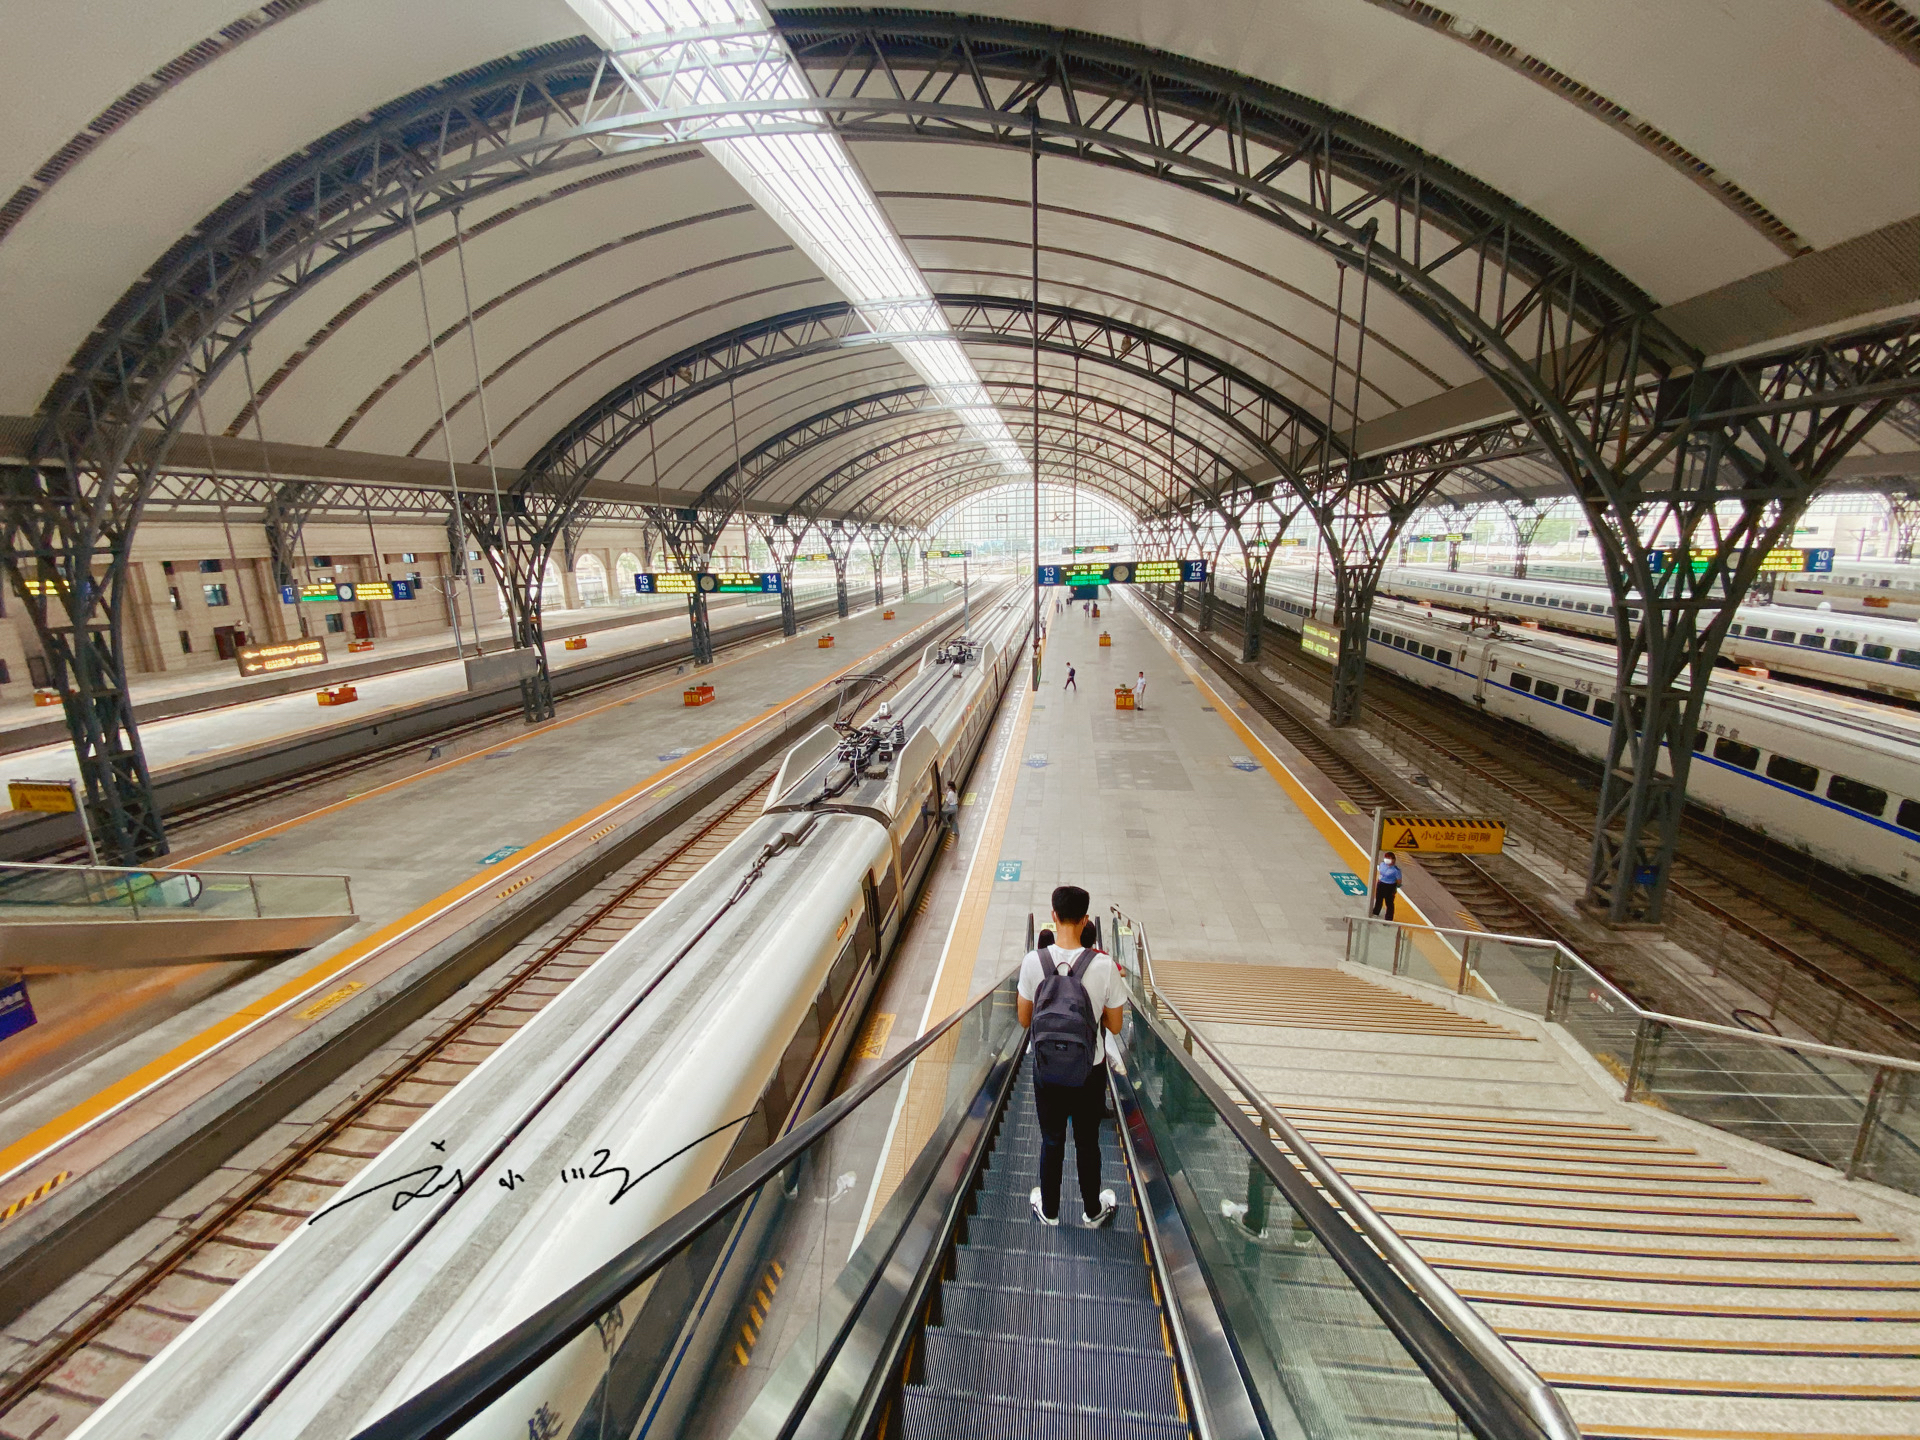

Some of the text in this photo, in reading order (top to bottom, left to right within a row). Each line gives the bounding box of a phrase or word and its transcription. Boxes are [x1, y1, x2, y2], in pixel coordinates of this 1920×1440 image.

[1816, 550, 1829, 561] 10
[1043, 567, 1055, 577] 13
[1191, 562, 1202, 572] 12
[638, 575, 649, 584] 15
[767, 574, 777, 584] 14
[285, 587, 294, 595] 17
[396, 583, 407, 591] 16
[1420, 830, 1491, 843] 小心站台间隙
